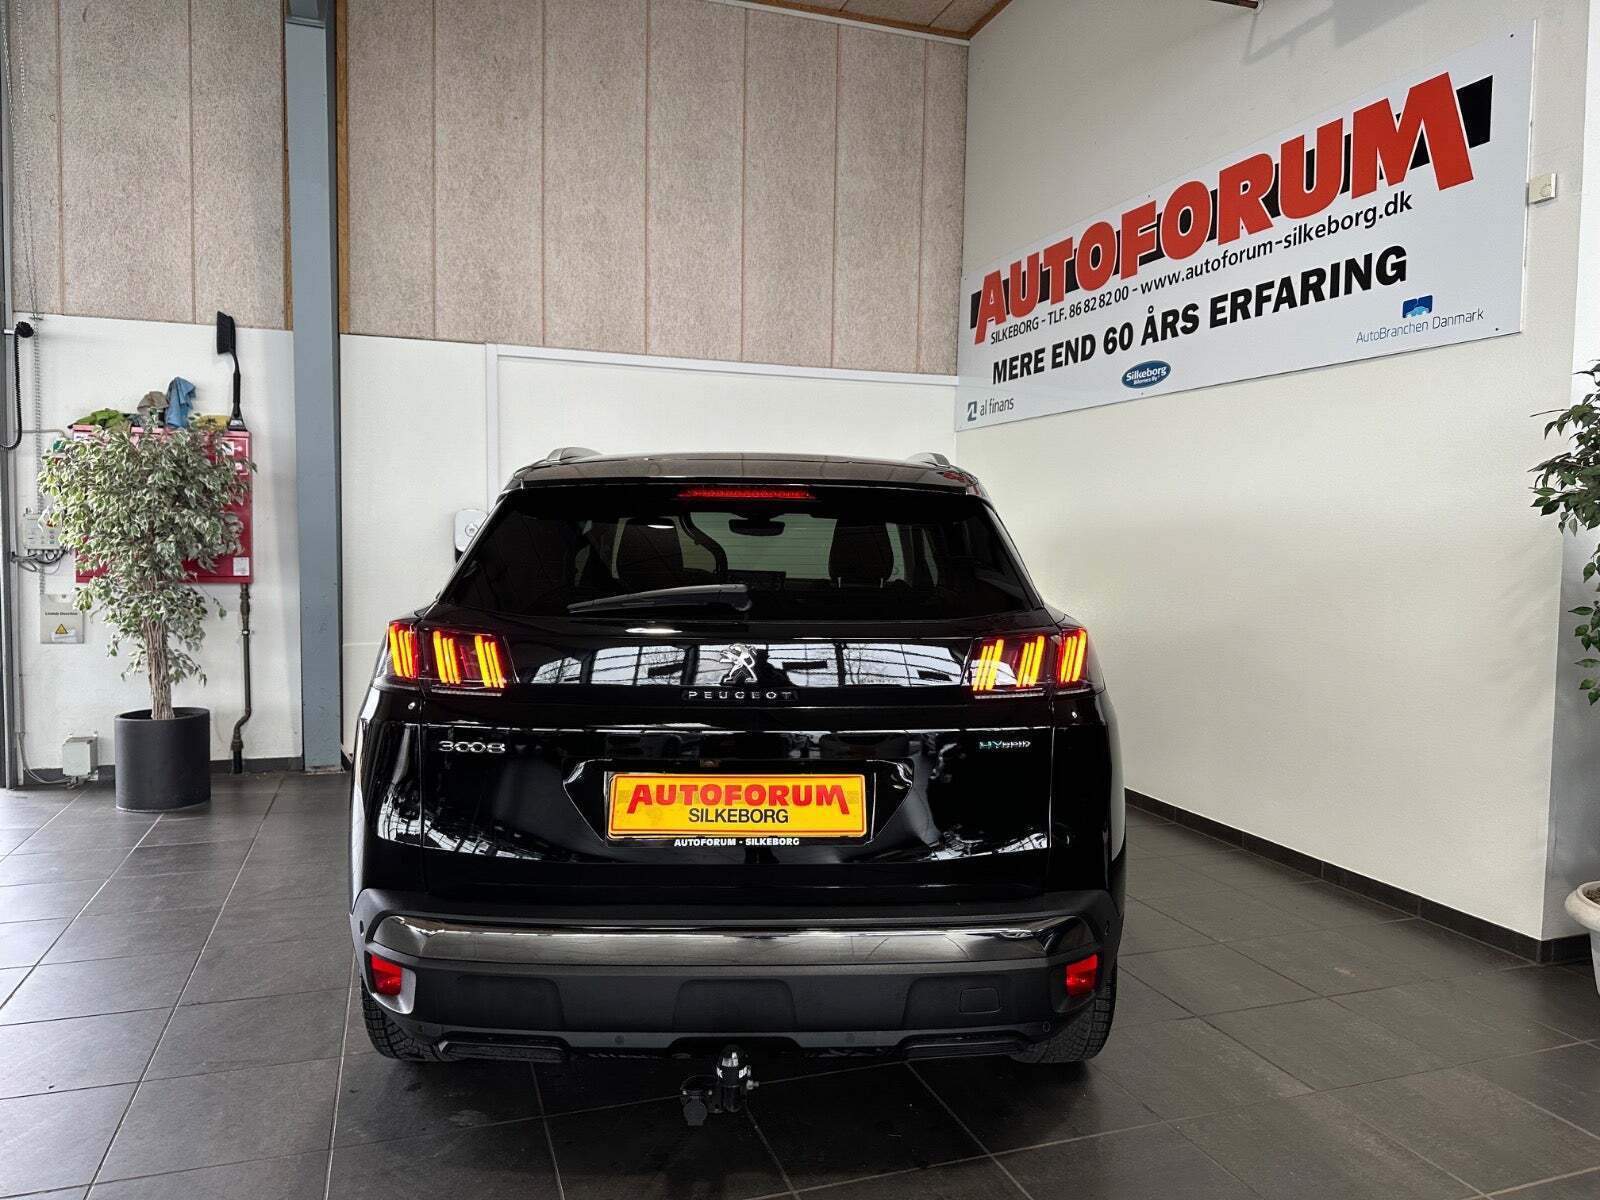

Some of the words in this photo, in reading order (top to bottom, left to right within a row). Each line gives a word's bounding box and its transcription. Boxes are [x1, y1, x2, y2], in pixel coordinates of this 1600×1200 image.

[974, 70, 1475, 346] AUTOFORUM
[990, 316, 1039, 345] SILKEBORG
[1047, 307, 1068, 325] TLF.
[1140, 190, 1413, 295] www.autoforum-silkeborg.dk
[992, 347, 1046, 385] MERE
[1051, 333, 1096, 369] END
[1103, 322, 1134, 355] 60
[1140, 304, 1200, 346] ÅRS
[1209, 245, 1408, 329] ERFARING
[1356, 321, 1429, 344] AutoBranchen
[1432, 307, 1484, 329] Danmark
[1125, 366, 1168, 382] Silkeborg
[979, 400, 988, 416] al
[989, 397, 1014, 414] finans
[688, 691, 793, 700] PEUGEOT
[438, 740, 506, 753] 3008
[979, 740, 1031, 749] HYBRID
[626, 783, 850, 815] AUTOFORUM
[688, 808, 789, 824] SILKEBORG
[673, 838, 736, 847] AUTOFORUM
[745, 837, 800, 847] SILKEBORG
